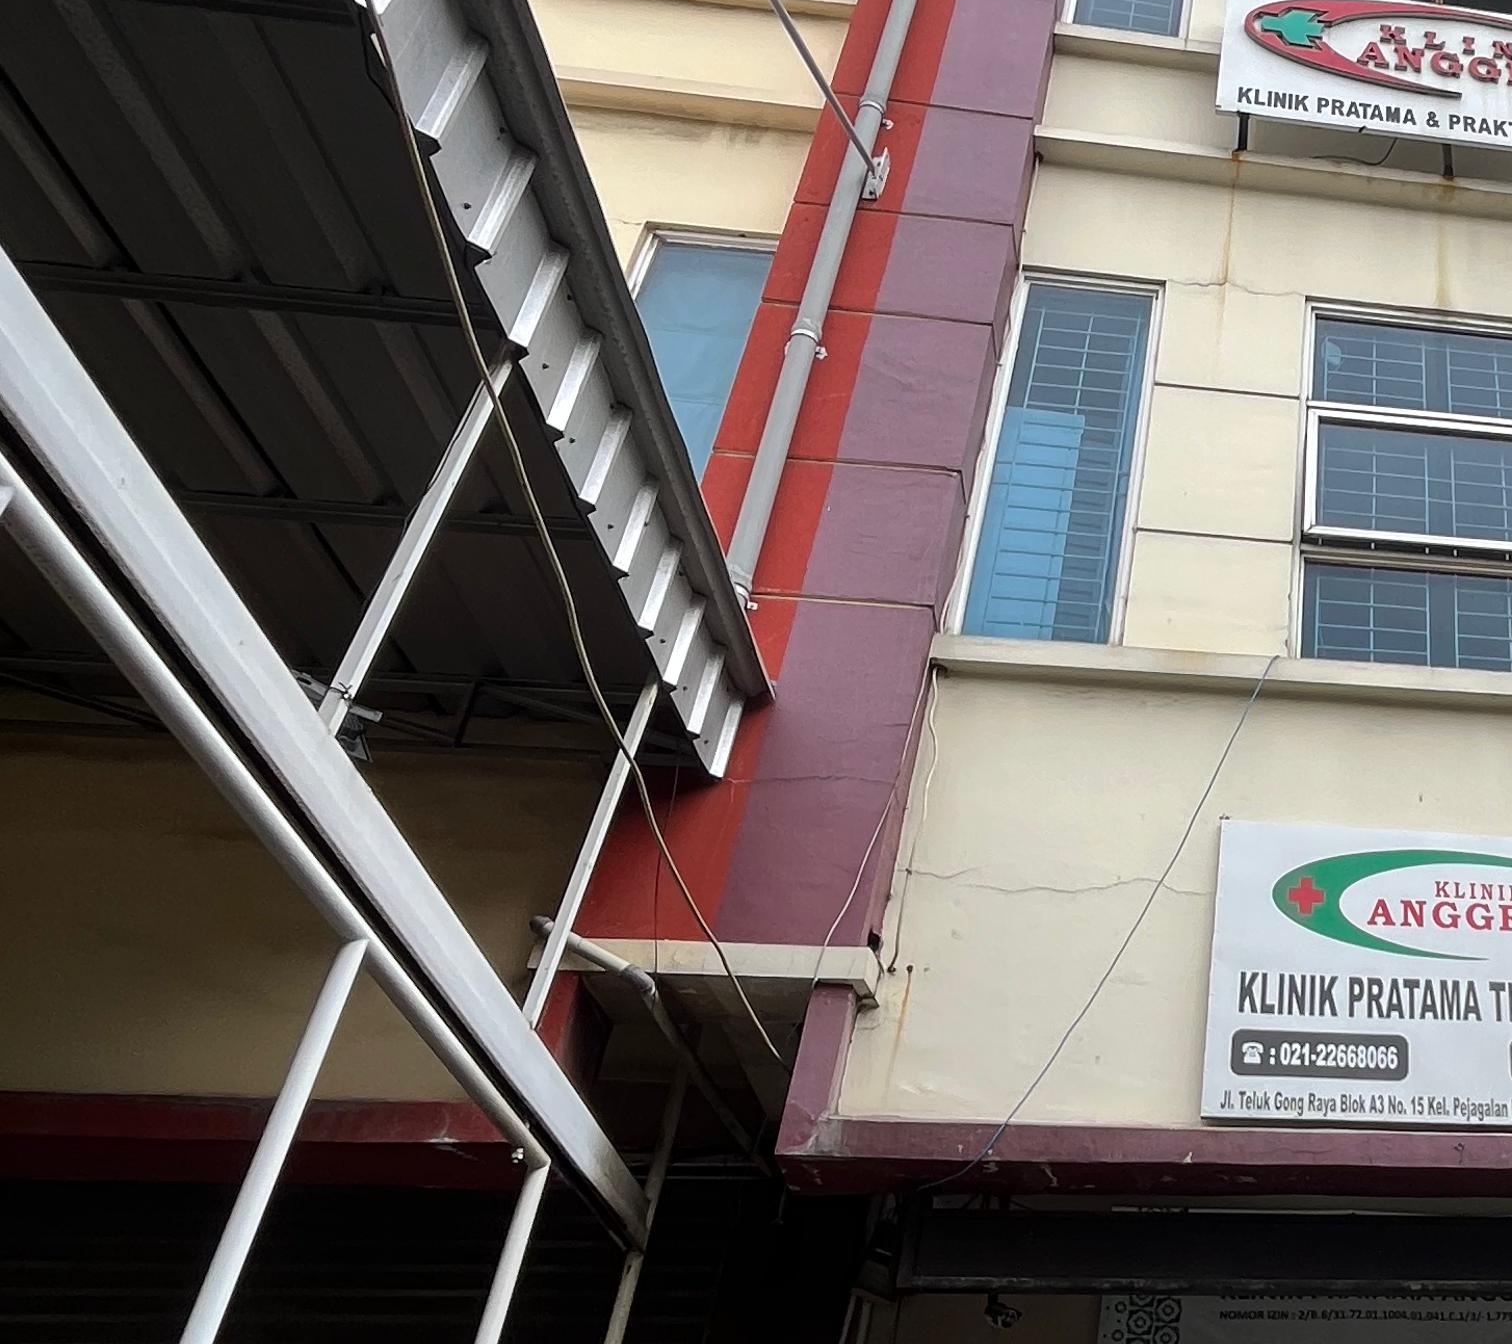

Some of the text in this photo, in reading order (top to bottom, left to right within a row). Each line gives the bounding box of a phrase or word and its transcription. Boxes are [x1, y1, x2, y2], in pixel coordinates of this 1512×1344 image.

[1237, 87, 1309, 112] KLINIK
[1316, 98, 1416, 126] PRATAMA
[1426, 111, 1440, 129] &
[1238, 971, 1338, 1017] KLINIK
[1348, 976, 1482, 1022] PRATAMA
[1280, 1042, 1398, 1069] 021-22668066
[1220, 1090, 1234, 1110] Jl.
[1239, 1091, 1271, 1111] Teluk
[1274, 1092, 1304, 1116] Gong
[1308, 1093, 1336, 1117] Raya
[1340, 1094, 1366, 1113] Blok
[1369, 1095, 1384, 1114] A3
[1388, 1095, 1407, 1115] No.
[1411, 1096, 1424, 1115] 15
[1428, 1097, 1450, 1116] Kel.
[1453, 1097, 1508, 1122] Pejagalan
[1219, 1311, 1265, 1320] NOMOR
[1267, 1311, 1289, 1320] IZIN
